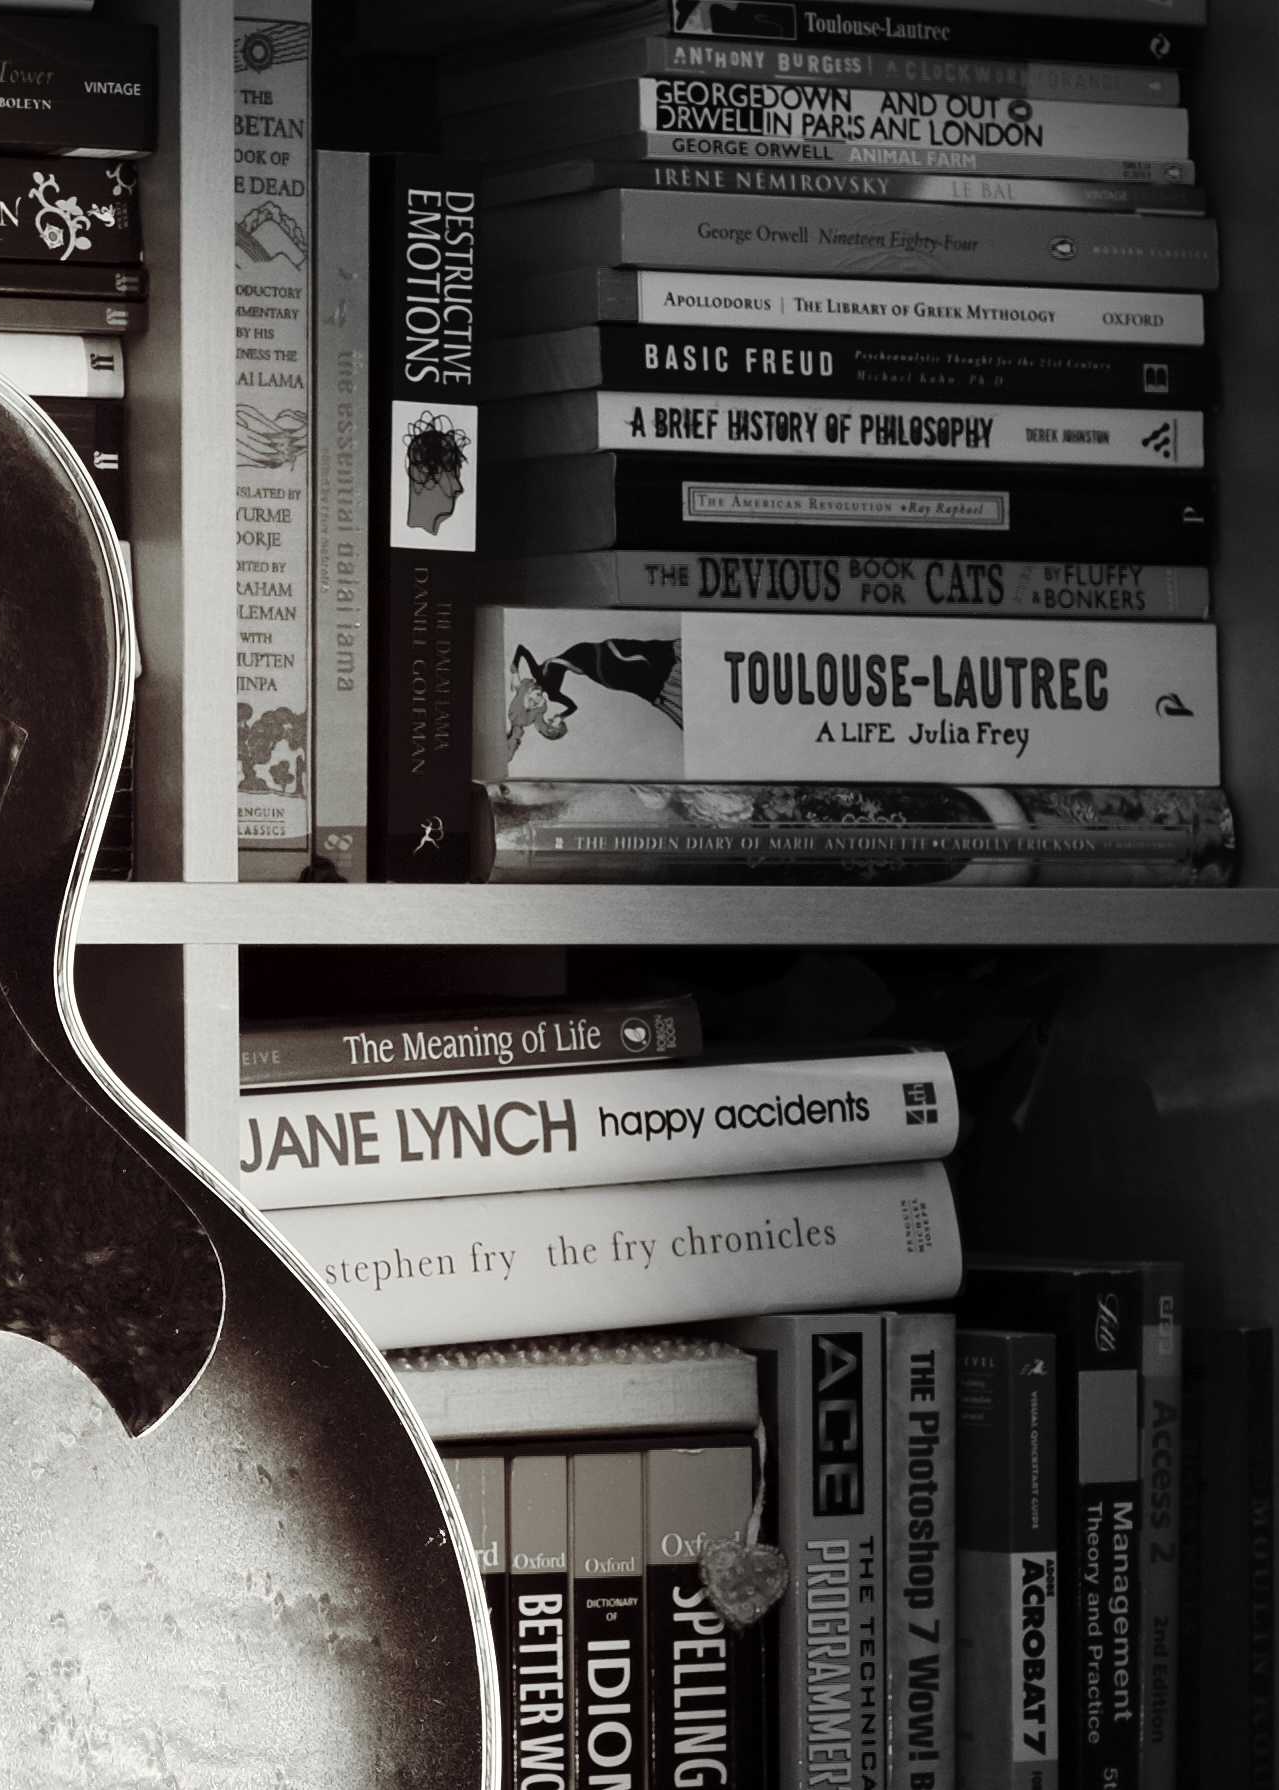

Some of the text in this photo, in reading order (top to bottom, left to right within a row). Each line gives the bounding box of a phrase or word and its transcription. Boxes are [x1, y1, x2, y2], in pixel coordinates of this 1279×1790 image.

[805, 11, 951, 41] Toulouse-Lautrec
[673, 46, 862, 75] ANTHONY BURGESS
[84, 81, 142, 96] VINTAGE
[240, 89, 273, 105] THE
[656, 80, 1000, 119] GEORGE DOWN AND OUT
[657, 105, 1043, 148] ORWELL IN PARIS LONDON
[270, 151, 290, 166] OF
[672, 137, 977, 171] GEORGE ORWELL ANIMAL FARM
[250, 176, 305, 197] DEAD
[981, 182, 1016, 200] BAL
[697, 222, 979, 253] George Orwell Nineteen Eighty-Four
[405, 188, 442, 384] EMOTIONS
[442, 190, 475, 386] DESTRUCTIVE
[664, 291, 1164, 327] APOLLODORUS THE LIBRARY OF GREEK MYTHOLOGY OXFORD
[236, 327, 275, 340] BY HIS
[273, 350, 297, 362] THE
[645, 344, 833, 376] BASIC FREUD
[258, 372, 305, 388] LAMA
[857, 370, 912, 383] Michael
[631, 406, 1110, 448] A BRIEF HISTORY OF PHILOSOPHY DEREK JOHNSTON
[288, 489, 301, 500] BY
[697, 494, 984, 517] THE AMERICAN REVOLUTION Ray Raphael
[272, 561, 287, 573] BY
[645, 557, 1144, 606] THE DEVIOUS BOOK CATS BY FLUFFY
[861, 583, 906, 604] FOR
[1044, 589, 1145, 611] BONKERS
[240, 632, 272, 644] WITH
[412, 567, 429, 774] DANIEL GOLEMAN
[435, 602, 452, 751] THE DALAI LAMA
[724, 651, 1108, 711] TOULOUSE-LAUTREC
[815, 719, 1030, 759] A LIFE Julia Frey
[575, 836, 607, 850] THE
[614, 836, 679, 850] HIDDEN
[685, 836, 735, 851] DIARY
[740, 836, 762, 851] OF
[769, 837, 816, 851] MARIE
[824, 837, 927, 851] ANTOINETTE
[940, 838, 1011, 852] CAROLLY
[1017, 838, 1096, 852] ERICKSON
[343, 1032, 394, 1065] The
[403, 1026, 514, 1065] Meaning
[521, 1021, 547, 1055] of
[553, 1019, 602, 1052] Life
[240, 1111, 380, 1173] JANE
[396, 1098, 577, 1162] LYNCH
[599, 1105, 705, 1142] happy
[714, 1091, 870, 1130] accidents
[325, 1216, 837, 1291] stephen fry the fry chronicles
[818, 1335, 859, 1511] ACE
[1030, 1391, 1040, 1496] VISUAL QUICKSTART
[512, 1552, 566, 1570] Oxford
[584, 1557, 635, 1574] Oxford
[859, 1535, 874, 1603] THE
[904, 1350, 940, 1761] THE Photoshop 7 Wow!
[1149, 1399, 1178, 1744] Access 2 2nd Edition
[1045, 1558, 1056, 1598] ADOBE
[586, 1597, 638, 1609] DICTIONARY
[1109, 1501, 1133, 1722] Management
[1084, 1501, 1103, 1744] Theory and Practice
[1022, 1558, 1046, 1725] ACROBAT
[518, 1594, 564, 1726] BETTER
[672, 1586, 728, 1788] SPELLING
[1023, 1730, 1047, 1756] 7
